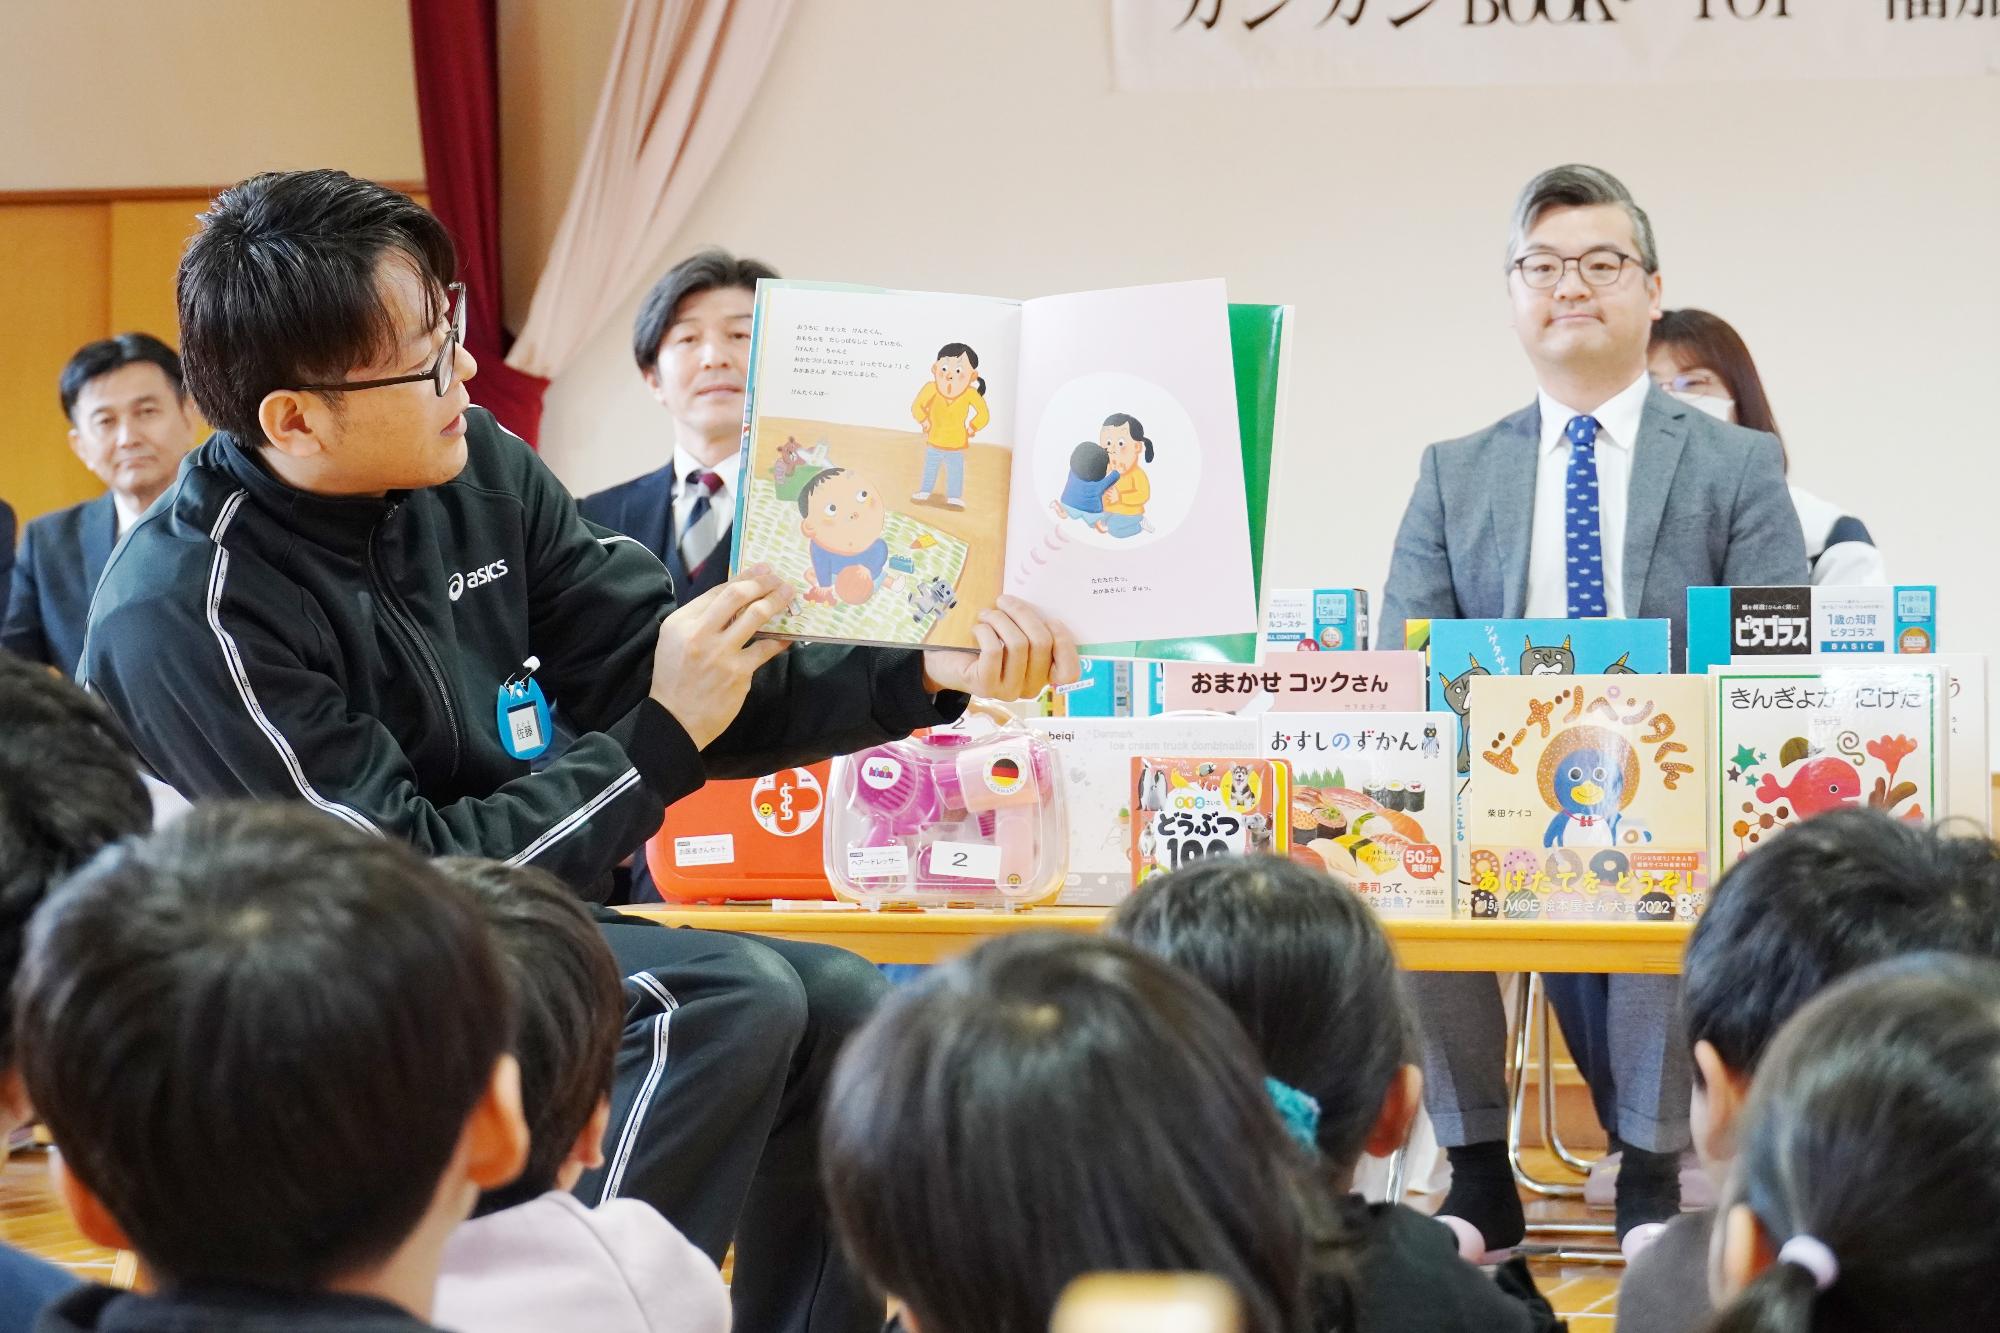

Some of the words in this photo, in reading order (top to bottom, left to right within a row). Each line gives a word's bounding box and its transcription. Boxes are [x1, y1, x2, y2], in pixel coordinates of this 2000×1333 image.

[467, 559, 508, 588] asics
[1827, 614, 1876, 625] 1歳の知育
[1735, 615, 1809, 648] ピタゴラス
[1831, 628, 1875, 637] ピタゴラス
[1191, 671, 1282, 693] おまかせ
[1289, 671, 1389, 693] コックさん
[1271, 730, 1419, 752] おすしのずかん
[1482, 685, 1694, 791] ドーナツペンタくん
[1158, 811, 1240, 836] どうぶつ
[1488, 808, 1533, 819] 柴田ケイコ
[952, 853, 968, 867] 2
[1479, 870, 1601, 893] あげたてを
[1616, 871, 1694, 895] どうぞ！
